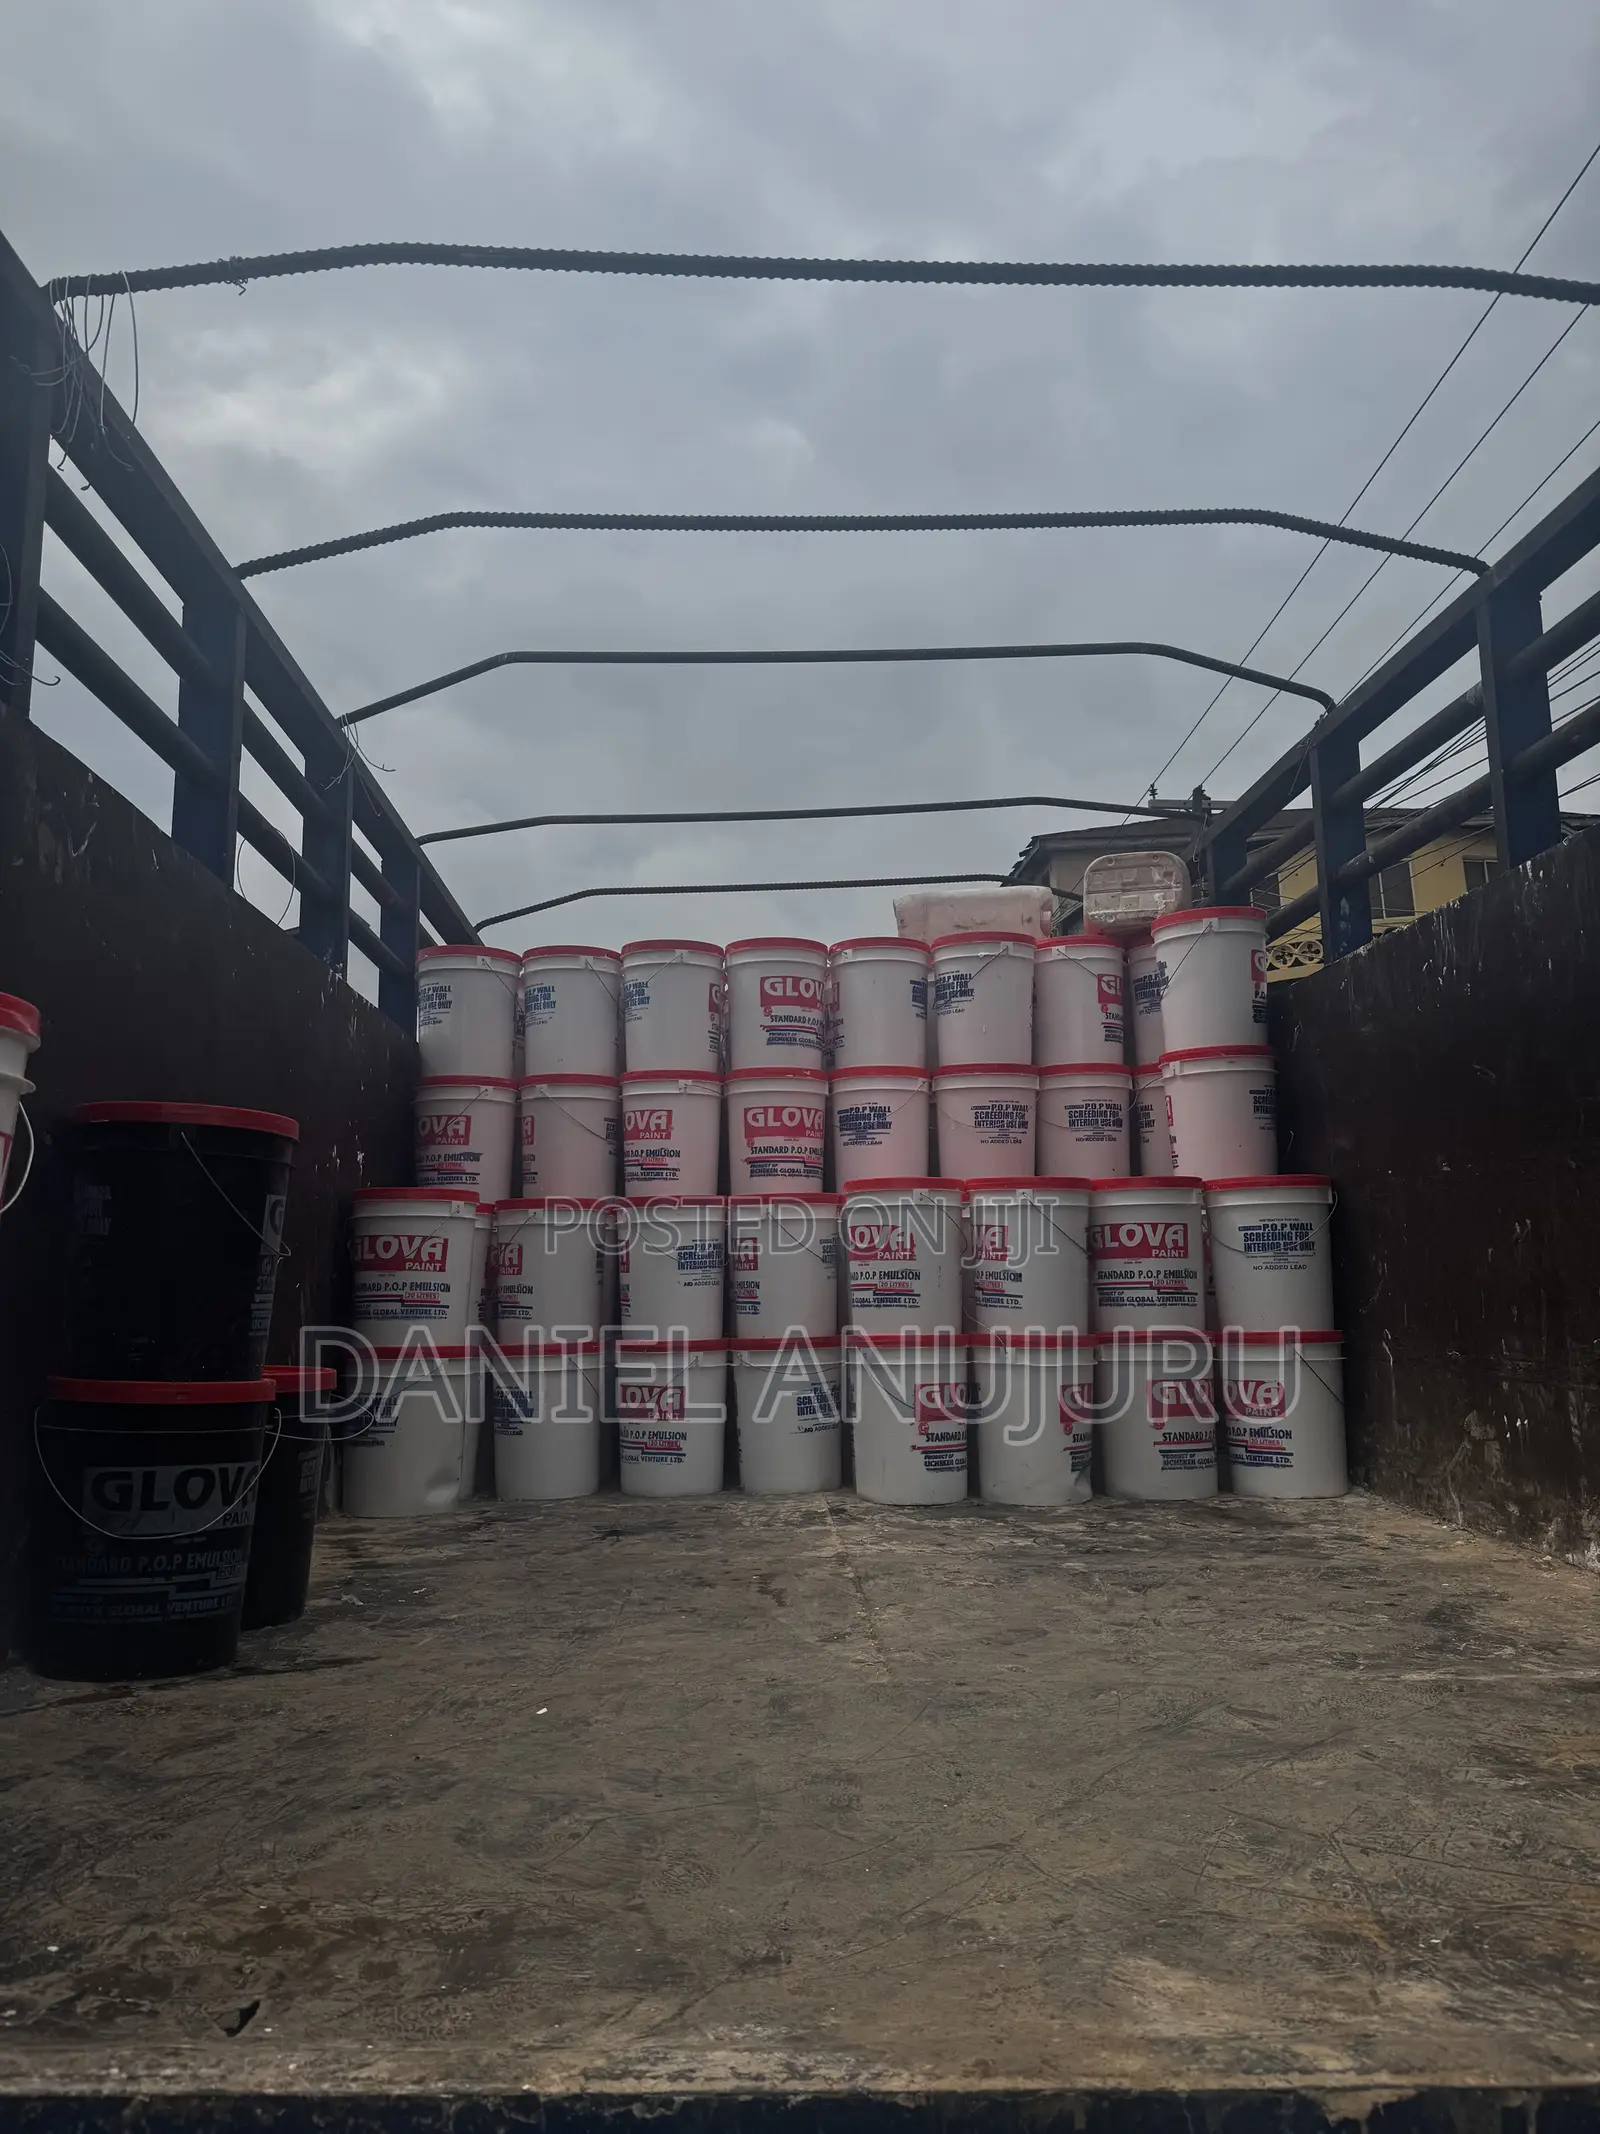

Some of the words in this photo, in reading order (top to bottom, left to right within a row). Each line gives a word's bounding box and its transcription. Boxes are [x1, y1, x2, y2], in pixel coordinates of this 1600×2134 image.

[953, 973, 973, 981] WALL
[764, 977, 823, 998] GLOV
[770, 1014, 806, 1023] STANDARD
[850, 1106, 868, 1114] P.O.P
[869, 1105, 891, 1113] WALL
[991, 1104, 1010, 1112] P.O.P
[1012, 1104, 1028, 1112] WALL
[1105, 1103, 1122, 1111] WALL
[747, 1109, 824, 1128] GLOVA
[839, 1113, 872, 1123] SCREEDING
[873, 1113, 887, 1121] FOR
[974, 1112, 1014, 1120] SCREEDING
[1015, 1112, 1026, 1120] FOR
[1068, 1110, 1108, 1119] SCREEDING
[1109, 1110, 1120, 1118] FOR
[417, 1115, 468, 1138] OVA
[863, 1122, 876, 1130] USE
[877, 1121, 892, 1129] ONLY
[974, 1120, 1005, 1129] INTERIOR
[1006, 1120, 1017, 1128] USE
[1068, 1118, 1099, 1127] INTERIOR
[1100, 1119, 1111, 1127] USE
[436, 1137, 465, 1146] PAINT
[646, 1148, 681, 1158] EMULSION
[750, 1146, 789, 1154] STANDARD
[791, 1146, 808, 1154] P.O.P
[1263, 1223, 1288, 1232] P.O.P
[1289, 1222, 1314, 1231] WALL
[1091, 1223, 1185, 1248] GLOVA
[1243, 1232, 1294, 1242] SCREEDING
[1295, 1231, 1310, 1241] FOR
[1244, 1242, 1282, 1252] INTERIOR
[1283, 1241, 1300, 1251] USE
[1300, 1241, 1316, 1251] ONLY
[678, 1250, 714, 1260] SCREEDING
[878, 1252, 912, 1260] PAINT
[1152, 1249, 1185, 1258] PAINT
[405, 1262, 442, 1271] PAINT
[860, 1272, 877, 1280] P.O.P
[879, 1270, 920, 1281] EMULSION
[985, 1270, 1023, 1282] EMULSION
[1098, 1270, 1136, 1280] STANDARD
[1138, 1270, 1161, 1280] P.O.P
[1163, 1269, 1198, 1280] EMULSION
[384, 1282, 408, 1292] P.O.P
[409, 1282, 451, 1293] EMULSION
[502, 1284, 533, 1294] EMULSION
[904, 1297, 919, 1305] LTD.
[400, 1308, 432, 1316] VENTURE
[919, 1384, 968, 1409] GLO
[1153, 1380, 1213, 1405] GLO
[1226, 1381, 1281, 1408] OVA
[648, 1411, 680, 1420] PAINT
[1245, 1407, 1281, 1417] PAINT
[630, 1431, 645, 1440] P.O.P
[647, 1430, 687, 1441] EMULSION
[925, 1431, 961, 1443] STANDARD
[1162, 1431, 1204, 1442] STANDARD
[1248, 1426, 1292, 1440] EMULSION
[1246, 1453, 1274, 1462] VENTURE
[1275, 1455, 1292, 1464] LTD.
[137, 1553, 183, 1573] P.O.P
[187, 1547, 243, 1569] EMULSION
